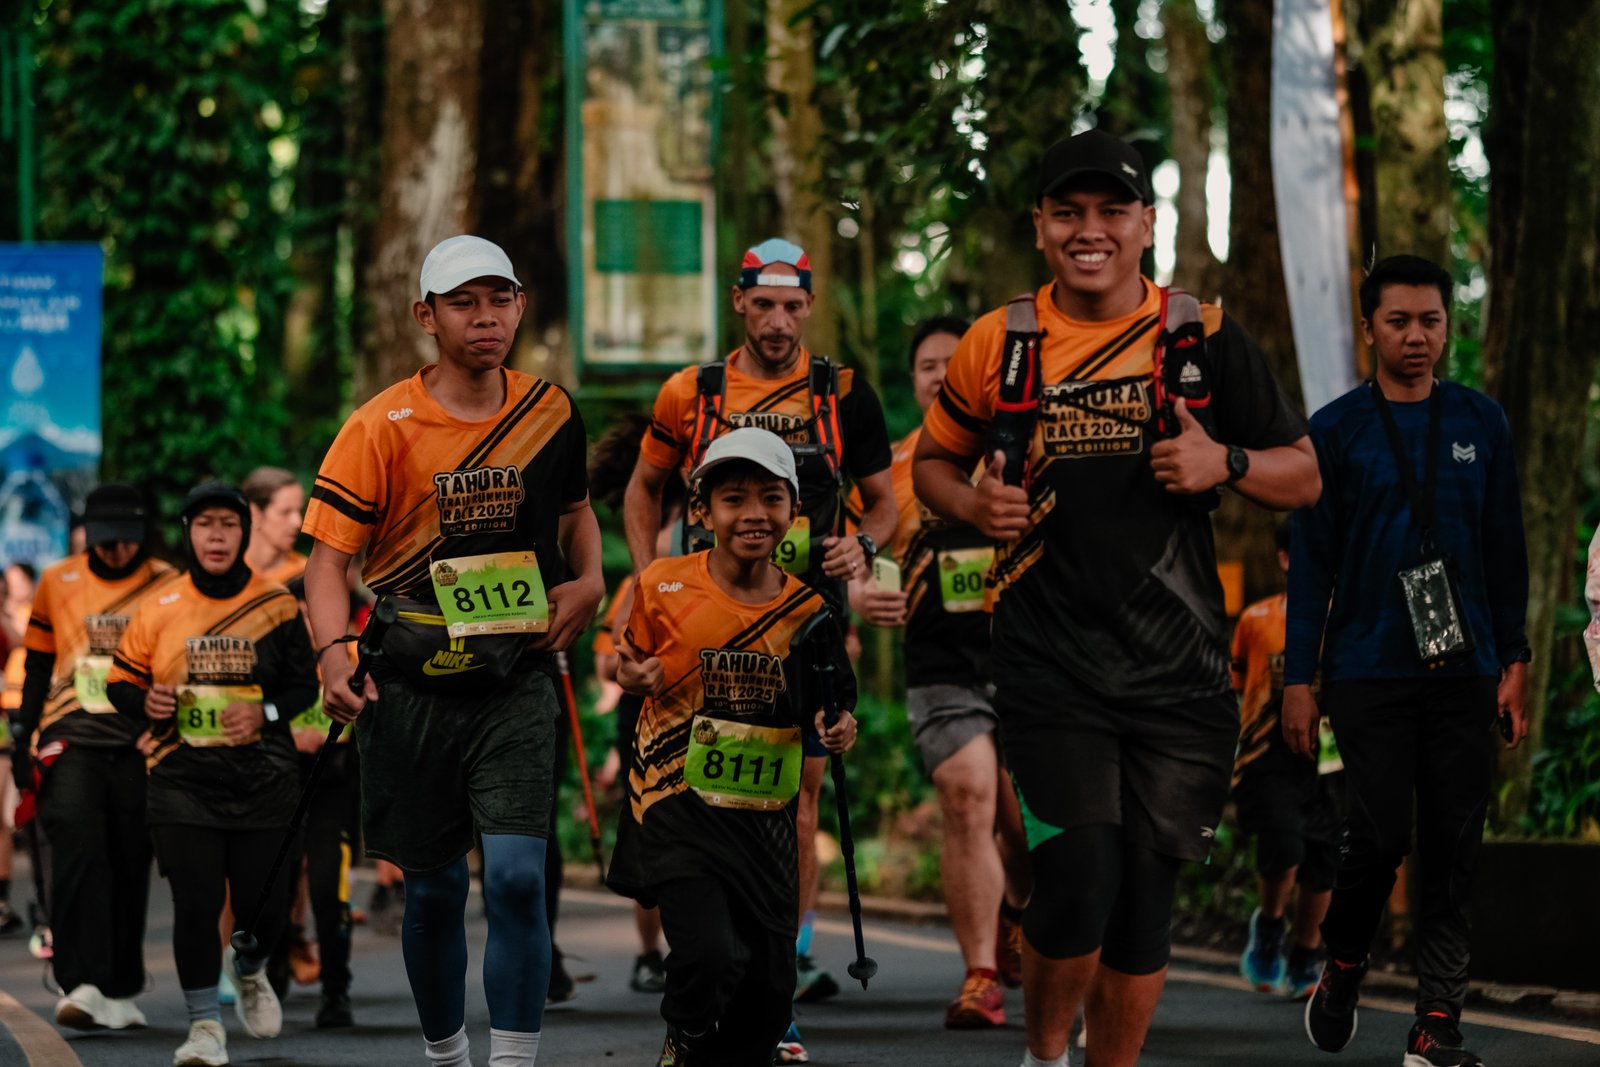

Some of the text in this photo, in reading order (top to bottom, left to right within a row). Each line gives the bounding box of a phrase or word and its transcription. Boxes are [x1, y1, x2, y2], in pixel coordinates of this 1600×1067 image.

[1047, 423, 1087, 438] RACE
[1077, 441, 1130, 452] EDITION
[437, 469, 519, 496] TAHURA
[472, 490, 521, 504] RUNNING
[443, 503, 513, 521] RACE 2025
[464, 521, 507, 531] EDITION
[453, 580, 534, 613] 8112
[188, 638, 252, 653] TAHURA
[432, 649, 474, 669] NIKE
[703, 651, 781, 677] TAHURA
[734, 674, 783, 689] RUNNING
[738, 686, 773, 701] 2025
[189, 708, 217, 729] 81
[702, 749, 783, 786] 8111
